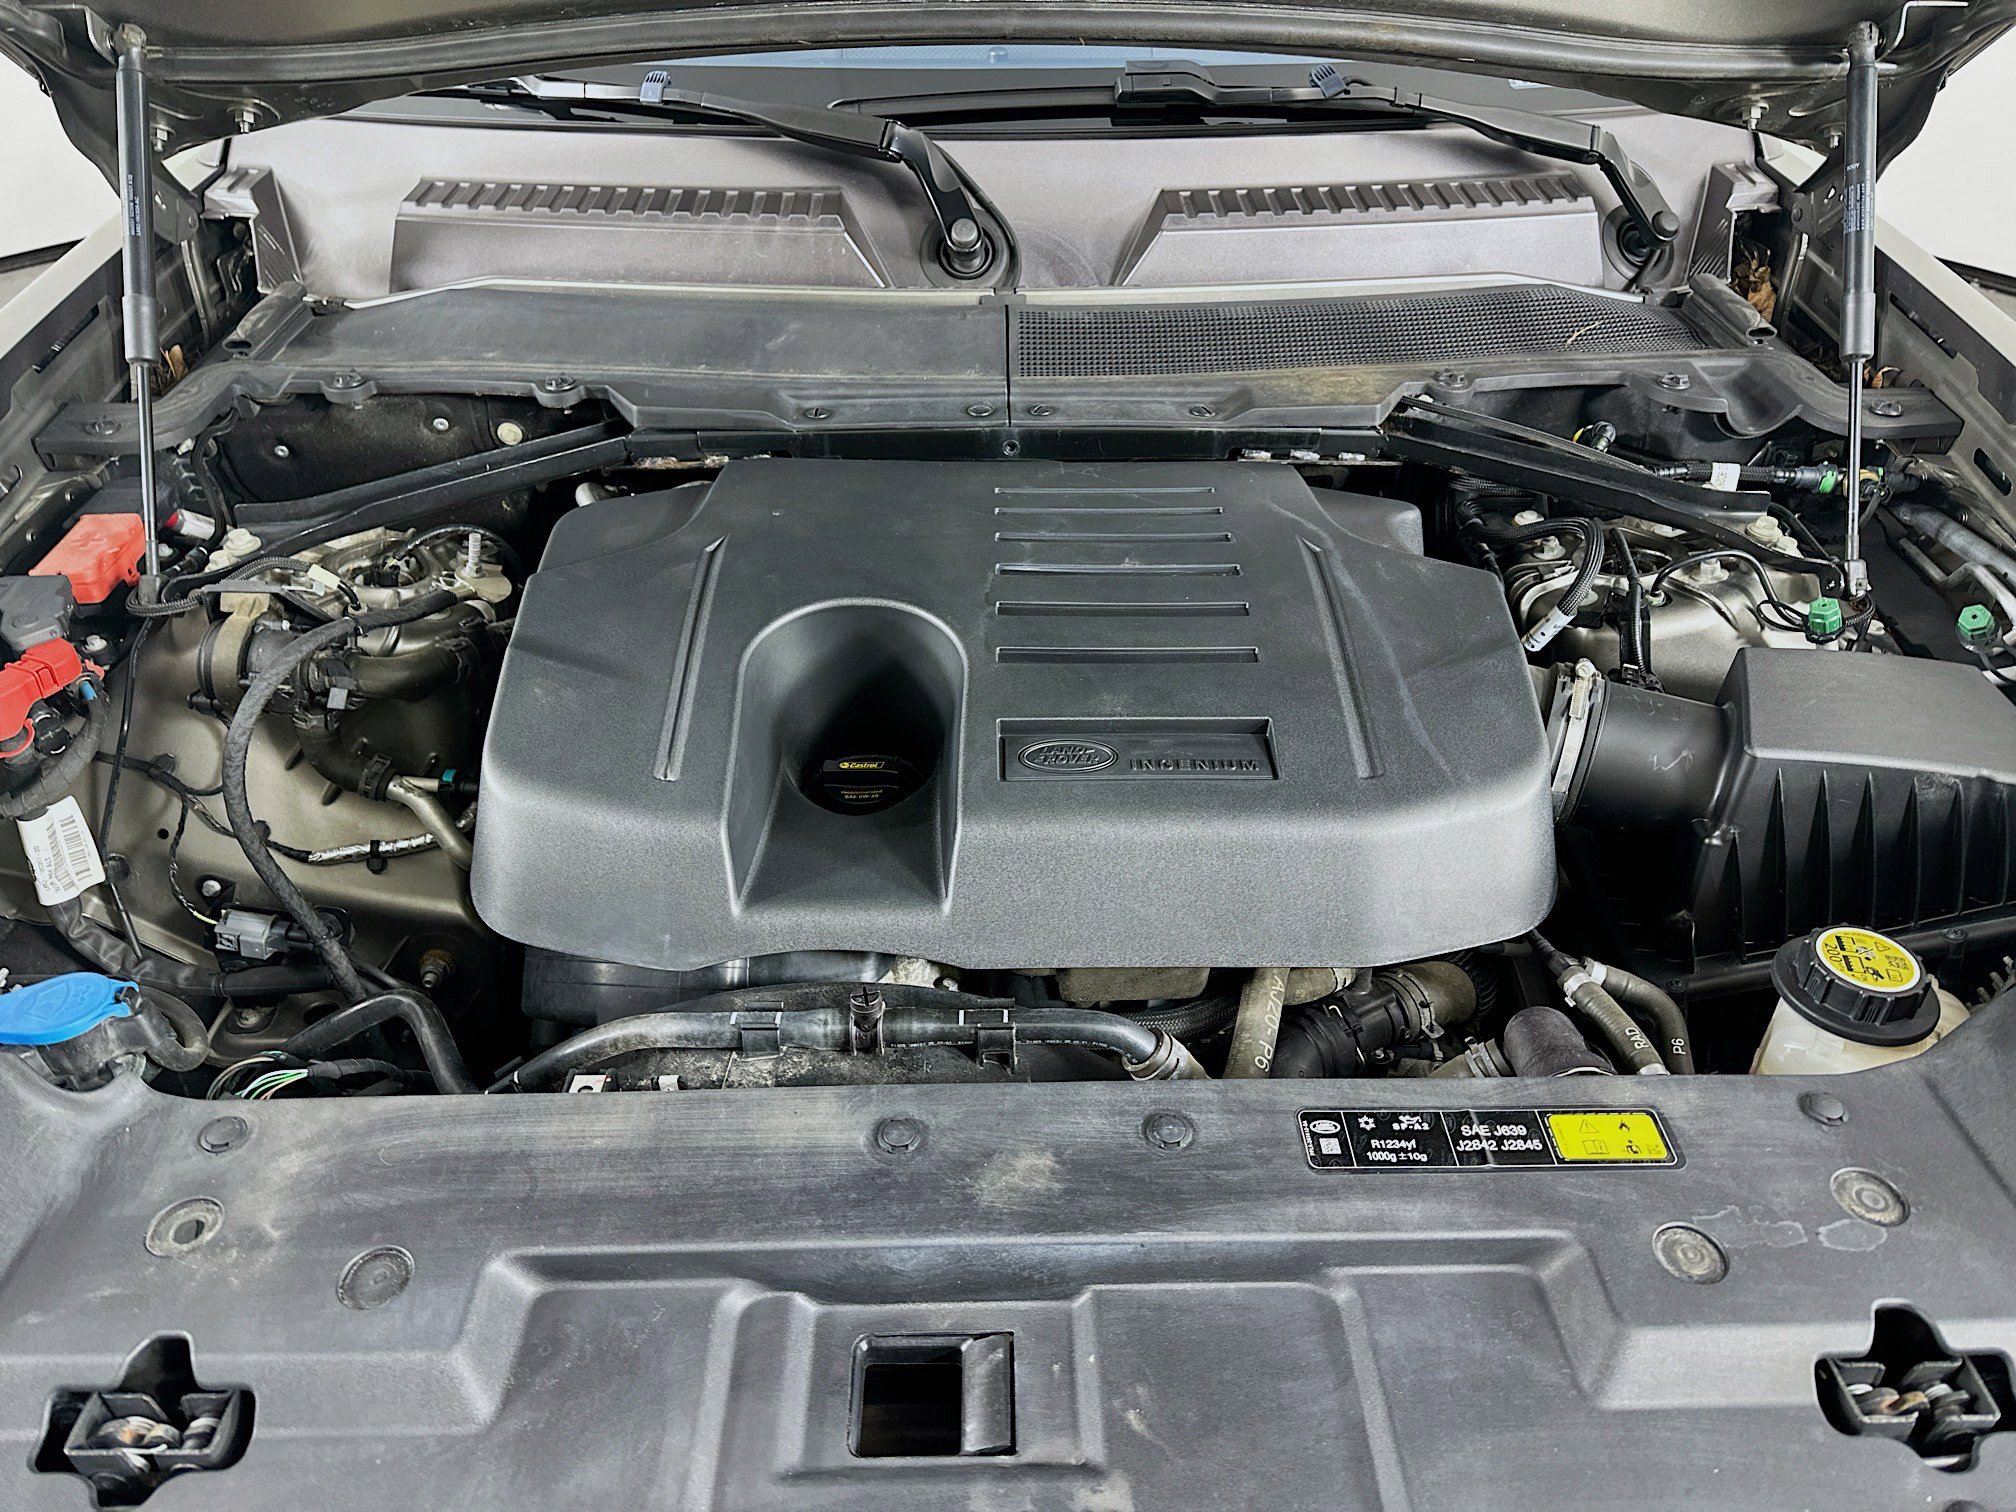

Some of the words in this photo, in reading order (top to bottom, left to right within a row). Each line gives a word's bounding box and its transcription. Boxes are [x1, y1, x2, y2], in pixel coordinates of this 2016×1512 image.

[1130, 758, 1261, 772] INGENIUM
[1824, 943, 1843, 963] 200
[1625, 1027, 1650, 1050] RAD
[1671, 1038, 1687, 1055] P6
[1460, 1124, 1492, 1137] SAE
[1493, 1124, 1528, 1136] J639
[1370, 1138, 1417, 1151] R1234yf
[1456, 1139, 1499, 1152] J2842
[1500, 1139, 1544, 1151] J2845
[1366, 1151, 1398, 1163] 1000g
